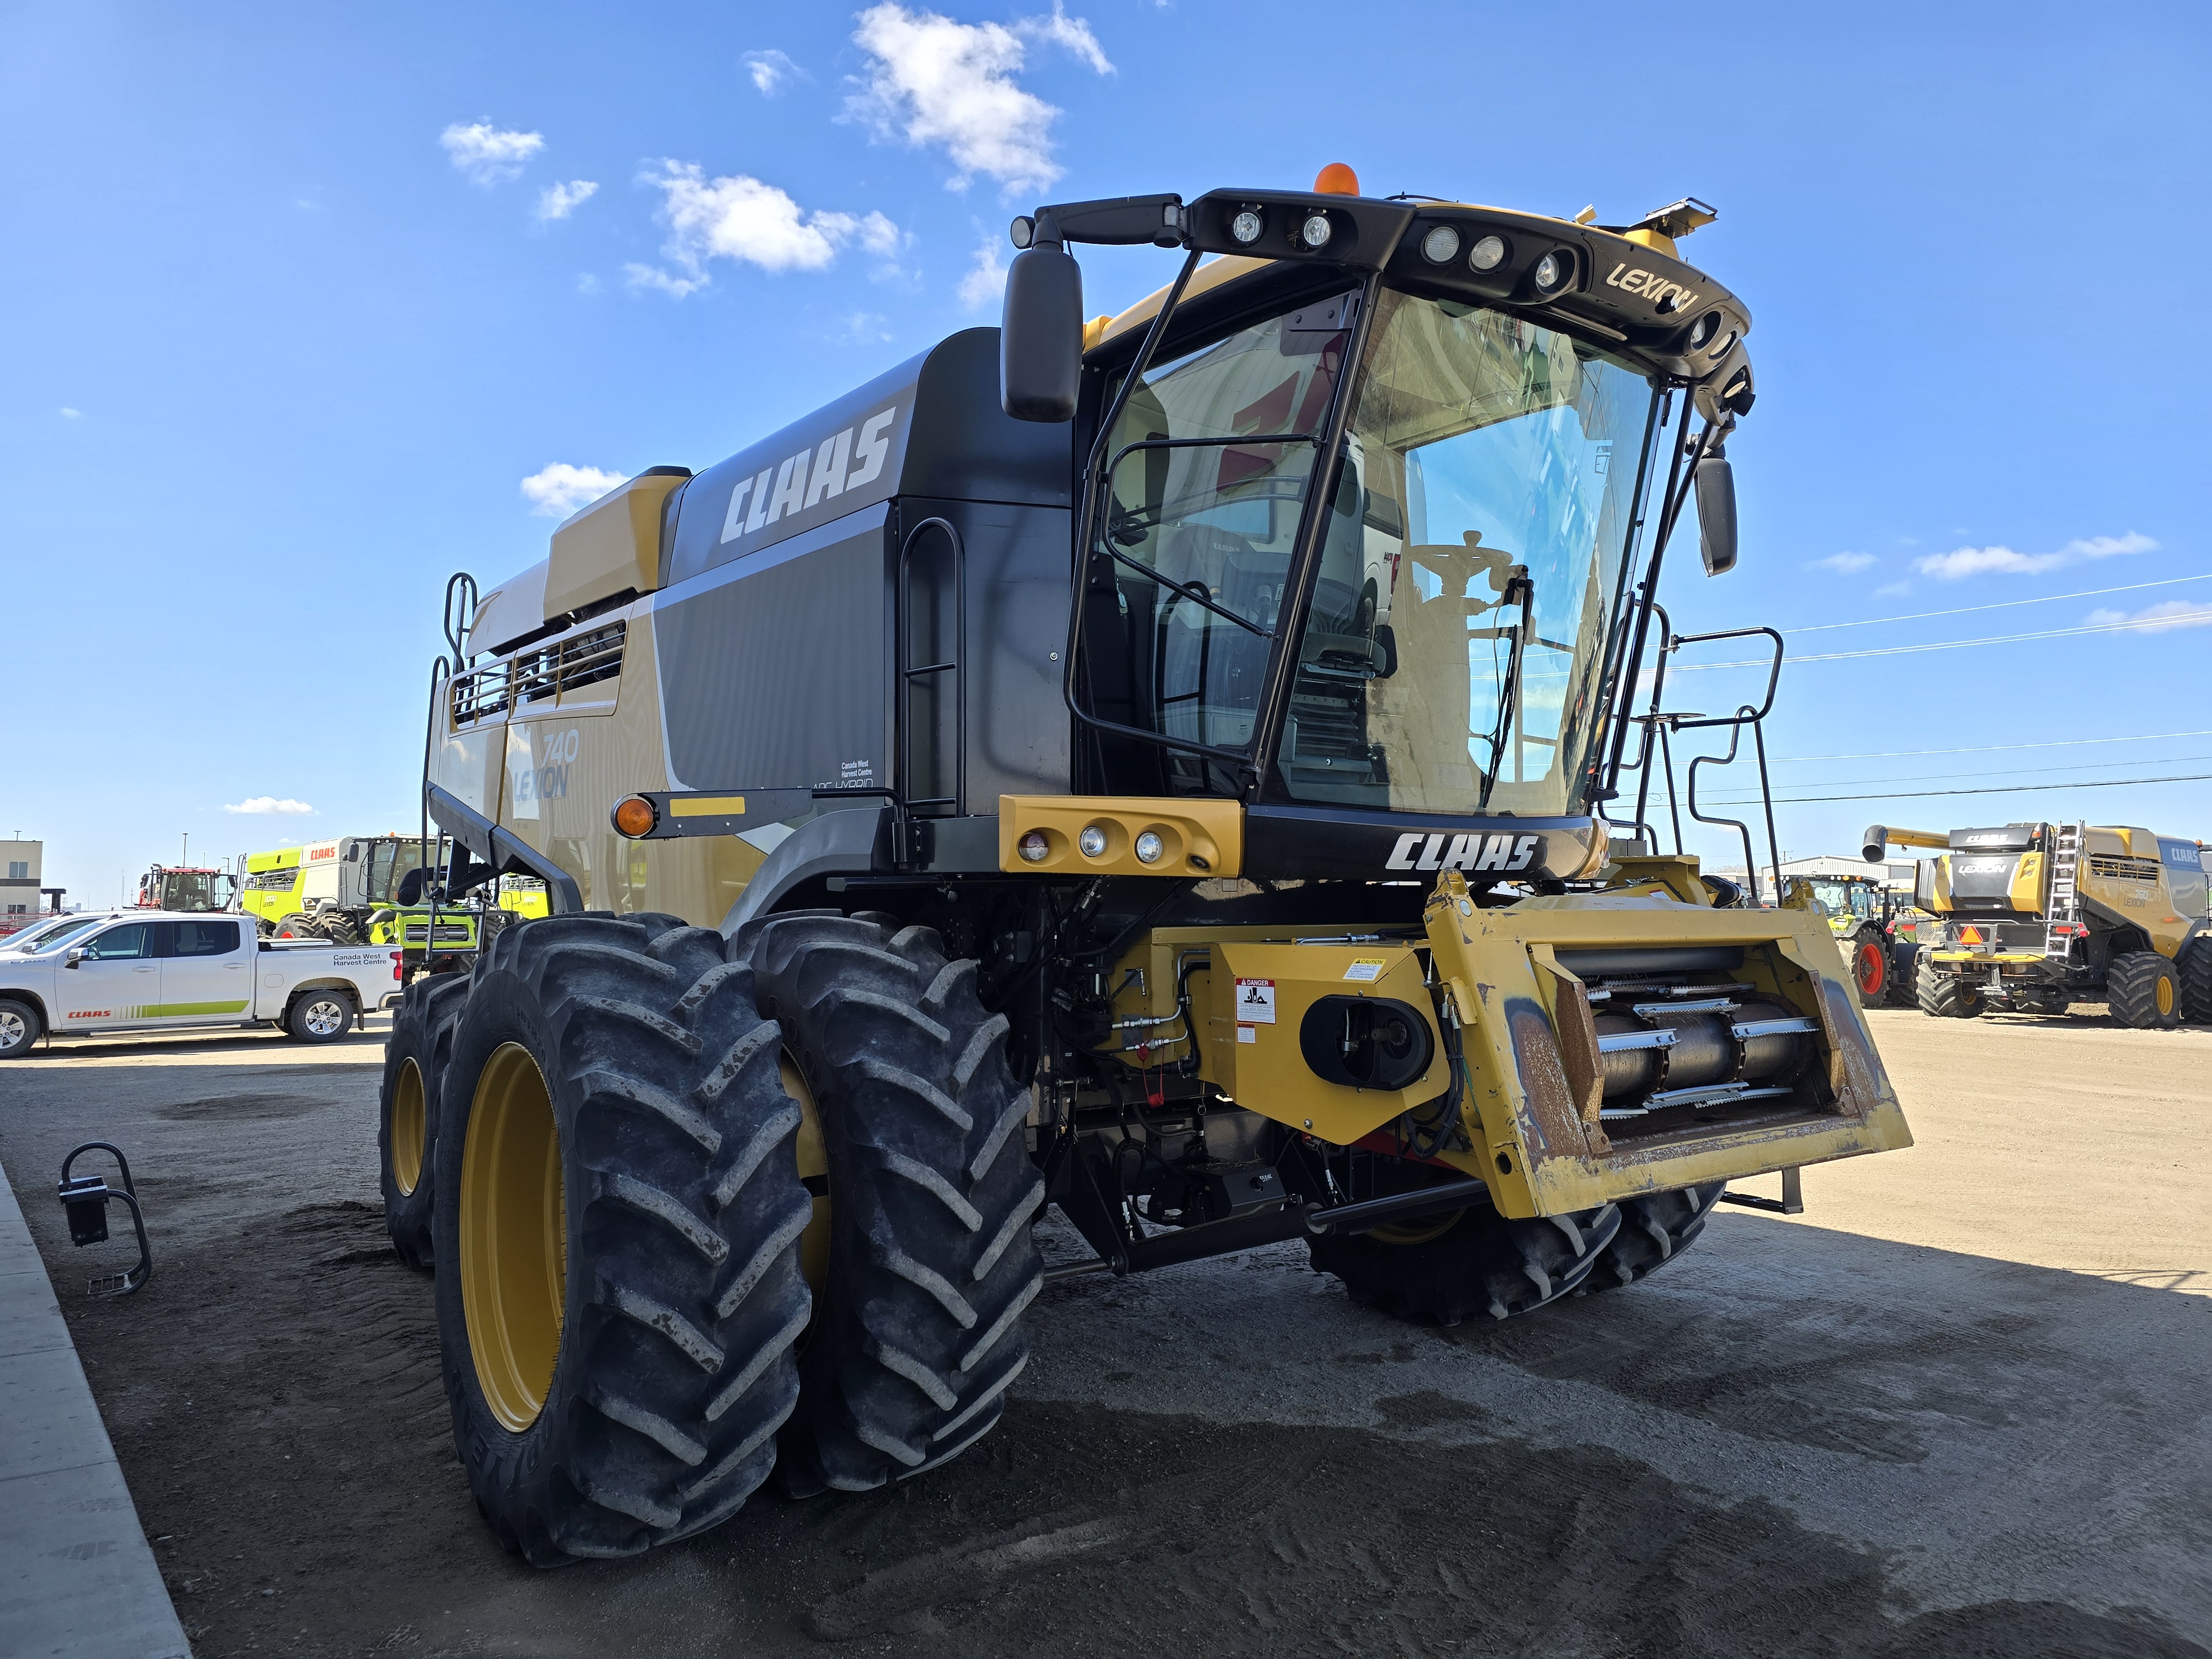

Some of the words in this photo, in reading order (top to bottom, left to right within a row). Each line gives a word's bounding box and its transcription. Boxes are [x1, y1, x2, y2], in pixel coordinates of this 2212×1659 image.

[1606, 263, 1699, 314] LEXION
[720, 406, 896, 544] CLAAS
[542, 729, 579, 767] 740
[841, 761, 857, 770] Canada
[857, 759, 869, 768] West
[514, 764, 569, 802] LEXION
[1965, 834, 2008, 843] CLAAS
[310, 847, 335, 860] CLAAS
[1385, 833, 1539, 870] CLAAS
[2171, 848, 2199, 863] CLAAS
[1958, 864, 2007, 874] LEXION
[2135, 889, 2148, 900] 760
[2124, 898, 2146, 908] LEXION
[68, 1010, 112, 1019] CLAAS
